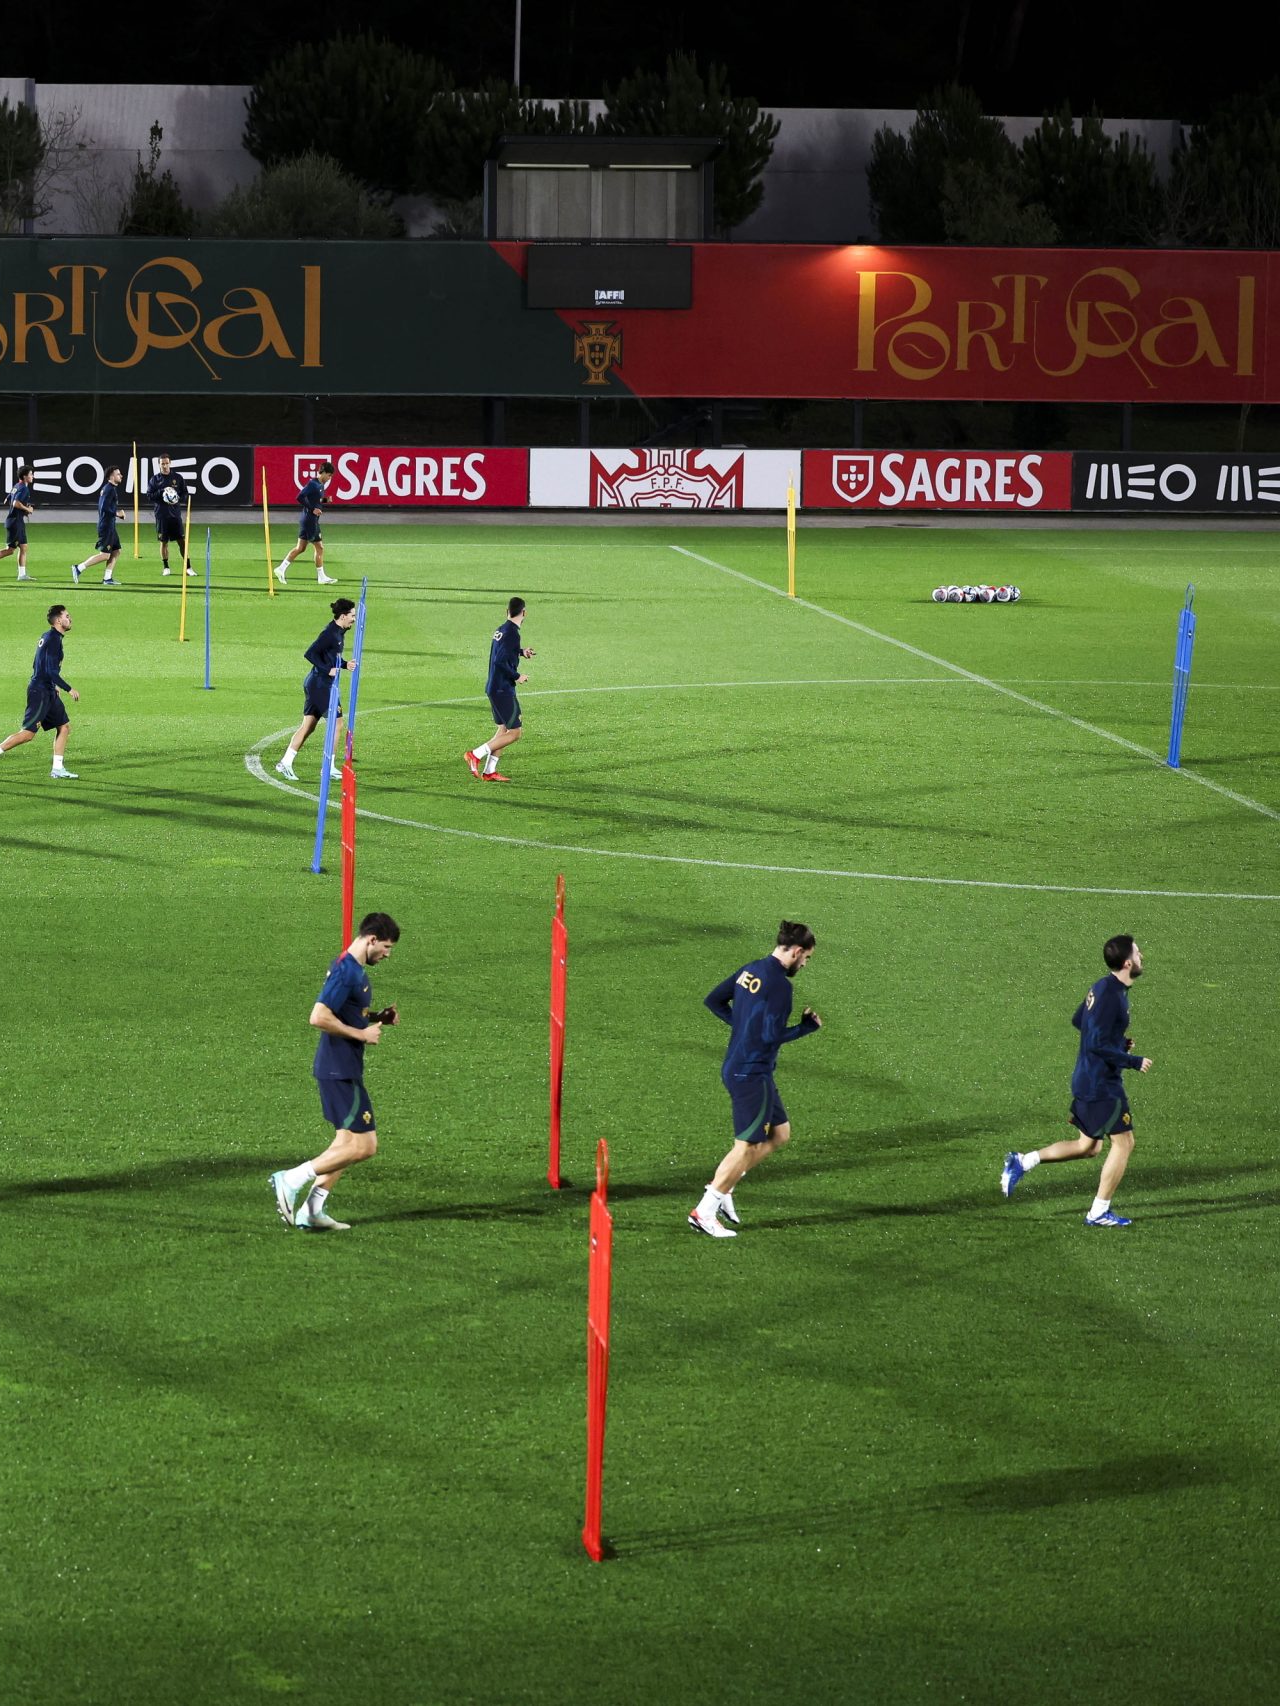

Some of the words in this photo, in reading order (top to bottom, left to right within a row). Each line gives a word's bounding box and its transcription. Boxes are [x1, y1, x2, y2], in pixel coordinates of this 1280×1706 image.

[336, 452, 487, 501] SAGRES
[650, 477, 685, 490] F.P.F.
[878, 453, 1044, 507] SAGRES
[1085, 463, 1197, 502] MEO
